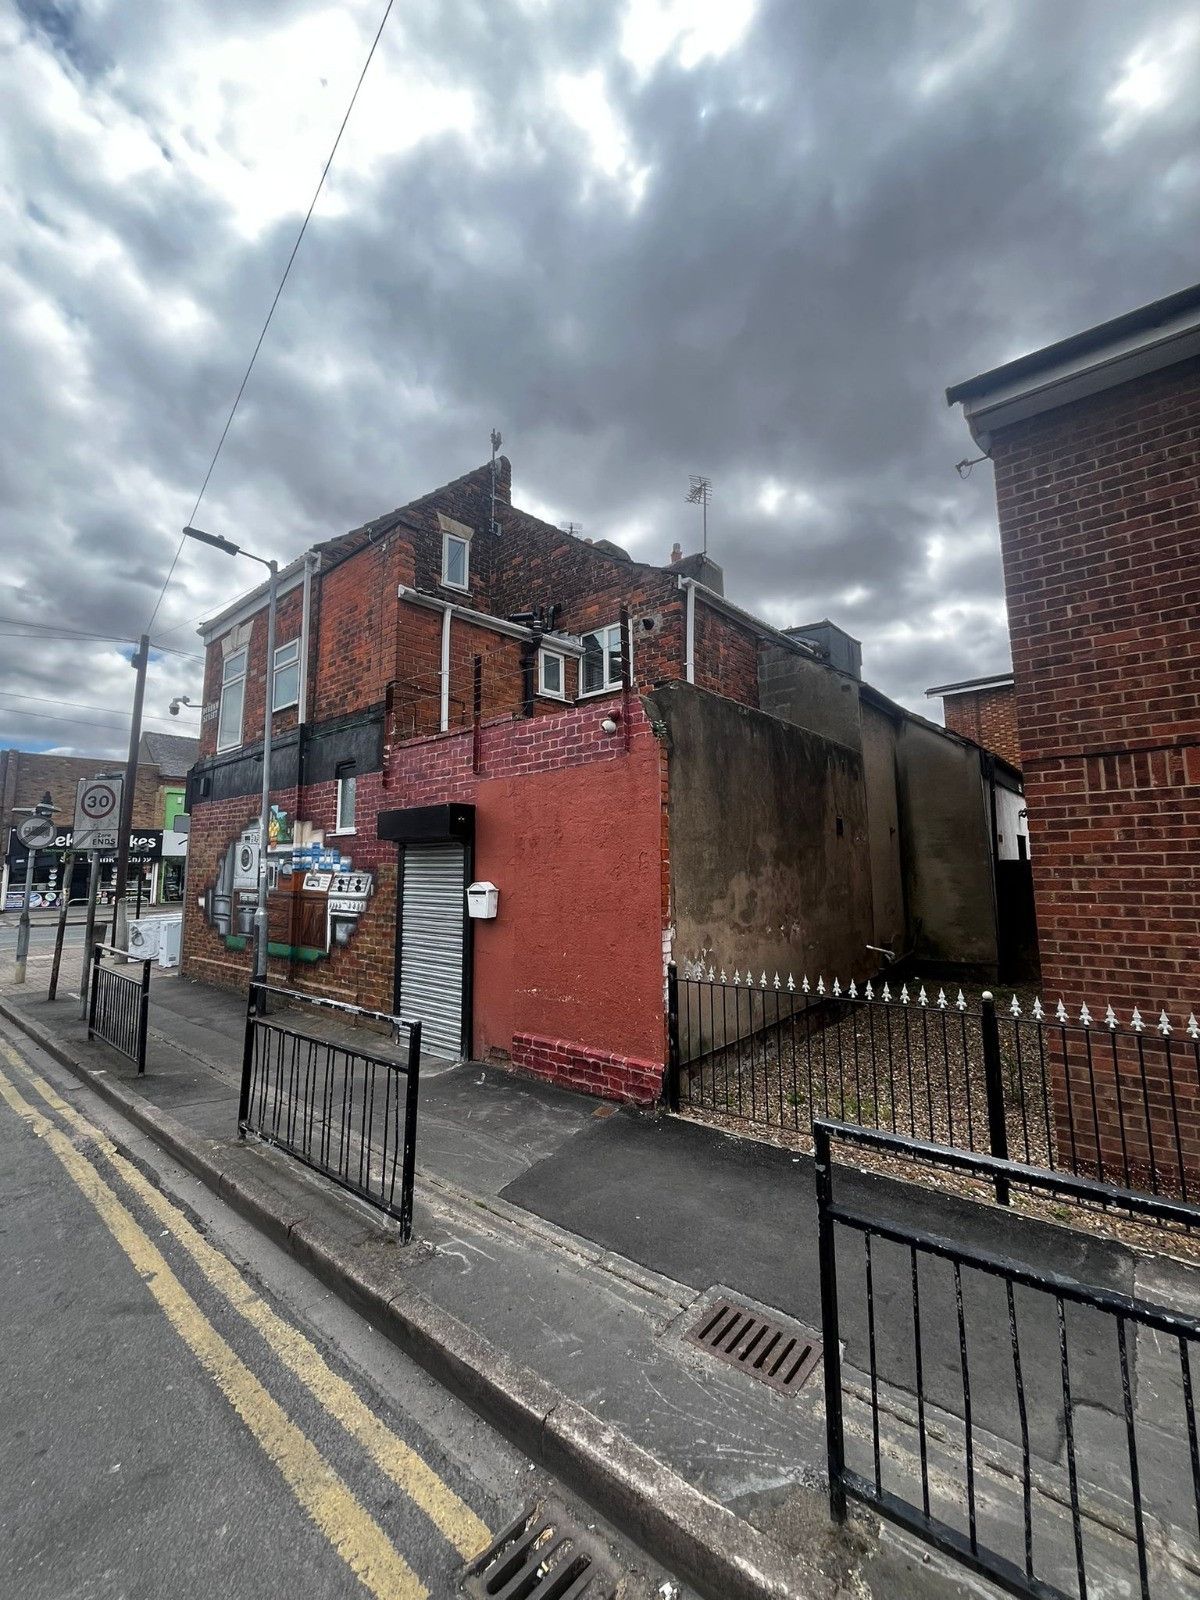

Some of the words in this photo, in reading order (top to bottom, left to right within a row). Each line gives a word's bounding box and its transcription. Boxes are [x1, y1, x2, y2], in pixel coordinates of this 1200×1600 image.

[87, 795, 110, 808] 30
[92, 838, 116, 846] ENDS
[129, 834, 157, 848] kes
